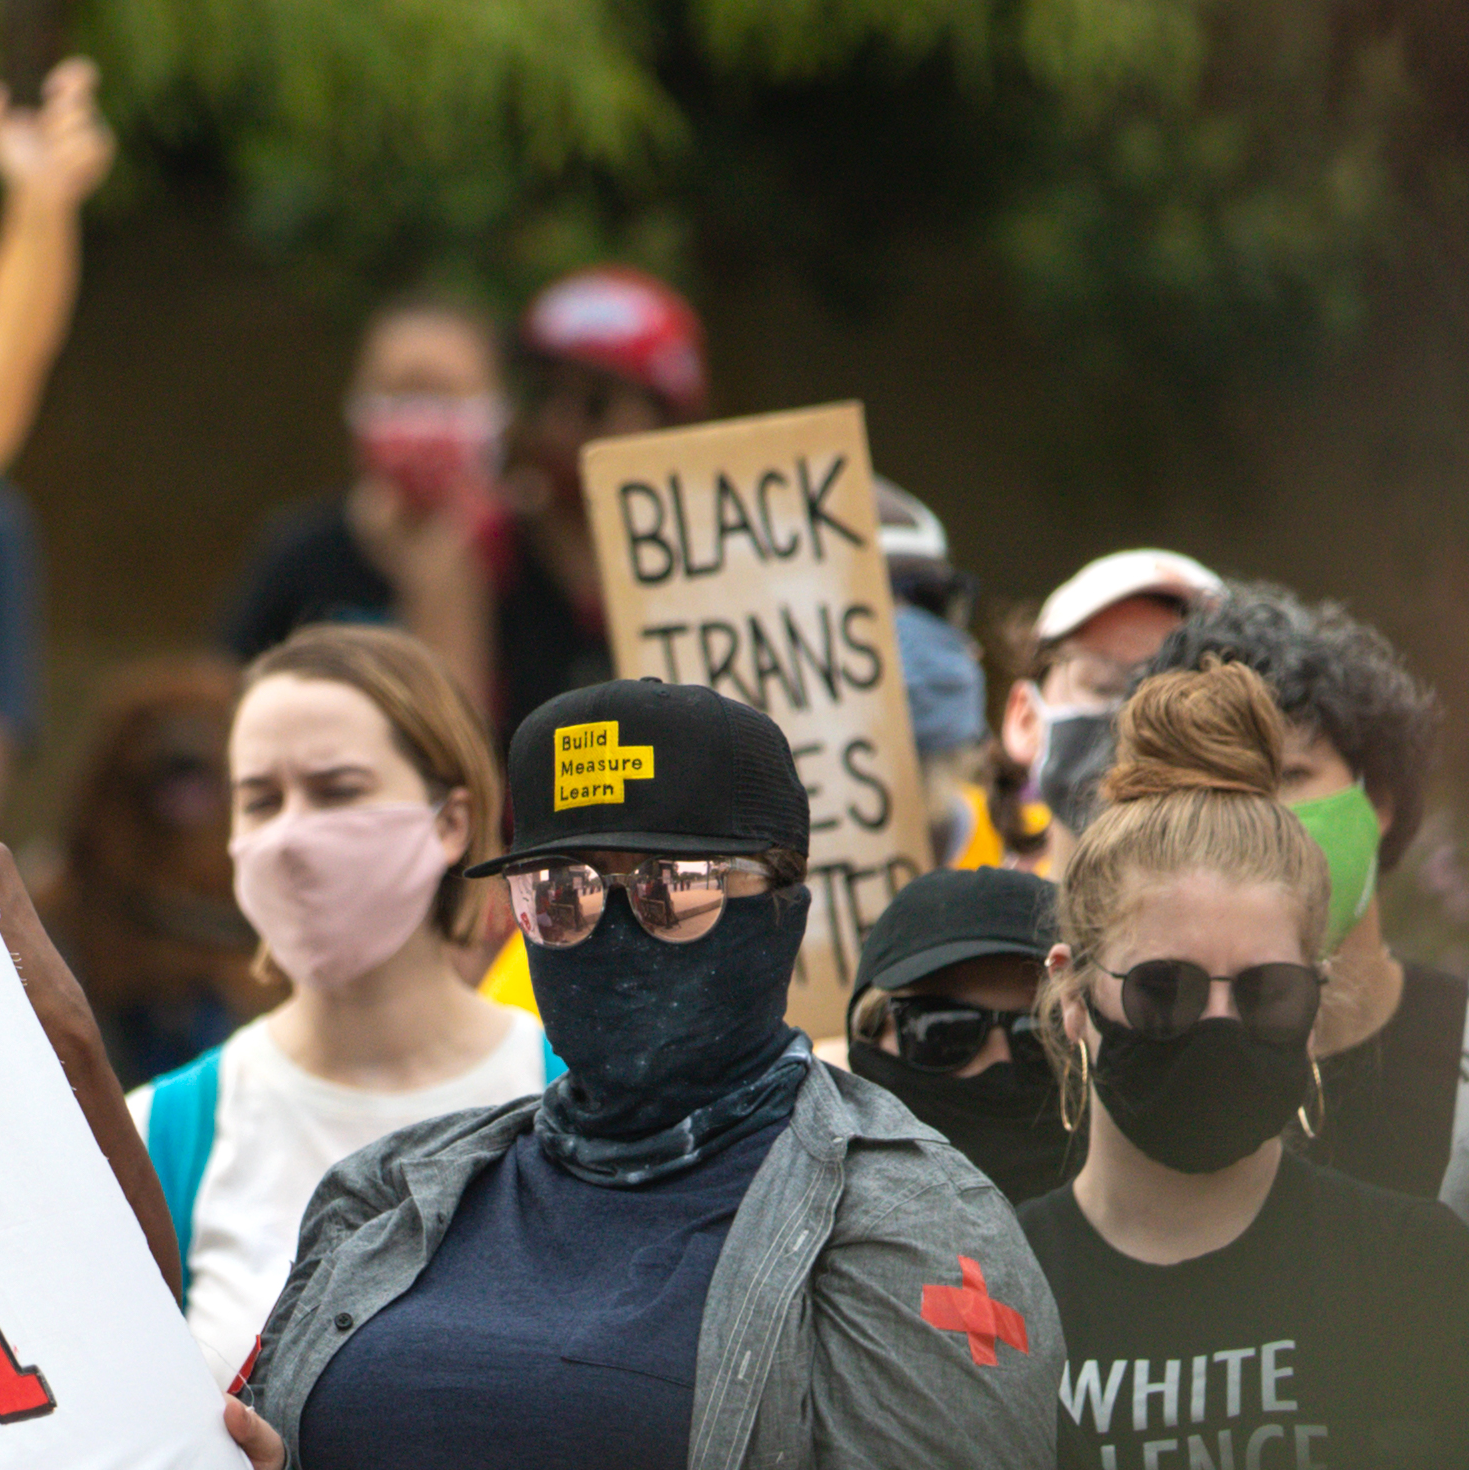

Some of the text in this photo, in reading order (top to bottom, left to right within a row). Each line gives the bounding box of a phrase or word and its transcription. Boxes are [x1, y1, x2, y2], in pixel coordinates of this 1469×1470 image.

[618, 453, 867, 585] BLACK
[639, 602, 885, 712] TRANS
[561, 757, 643, 777] Measure
[562, 730, 607, 751] Build
[560, 783, 614, 802] Learn
[1058, 1339, 1299, 1434] WHITE
